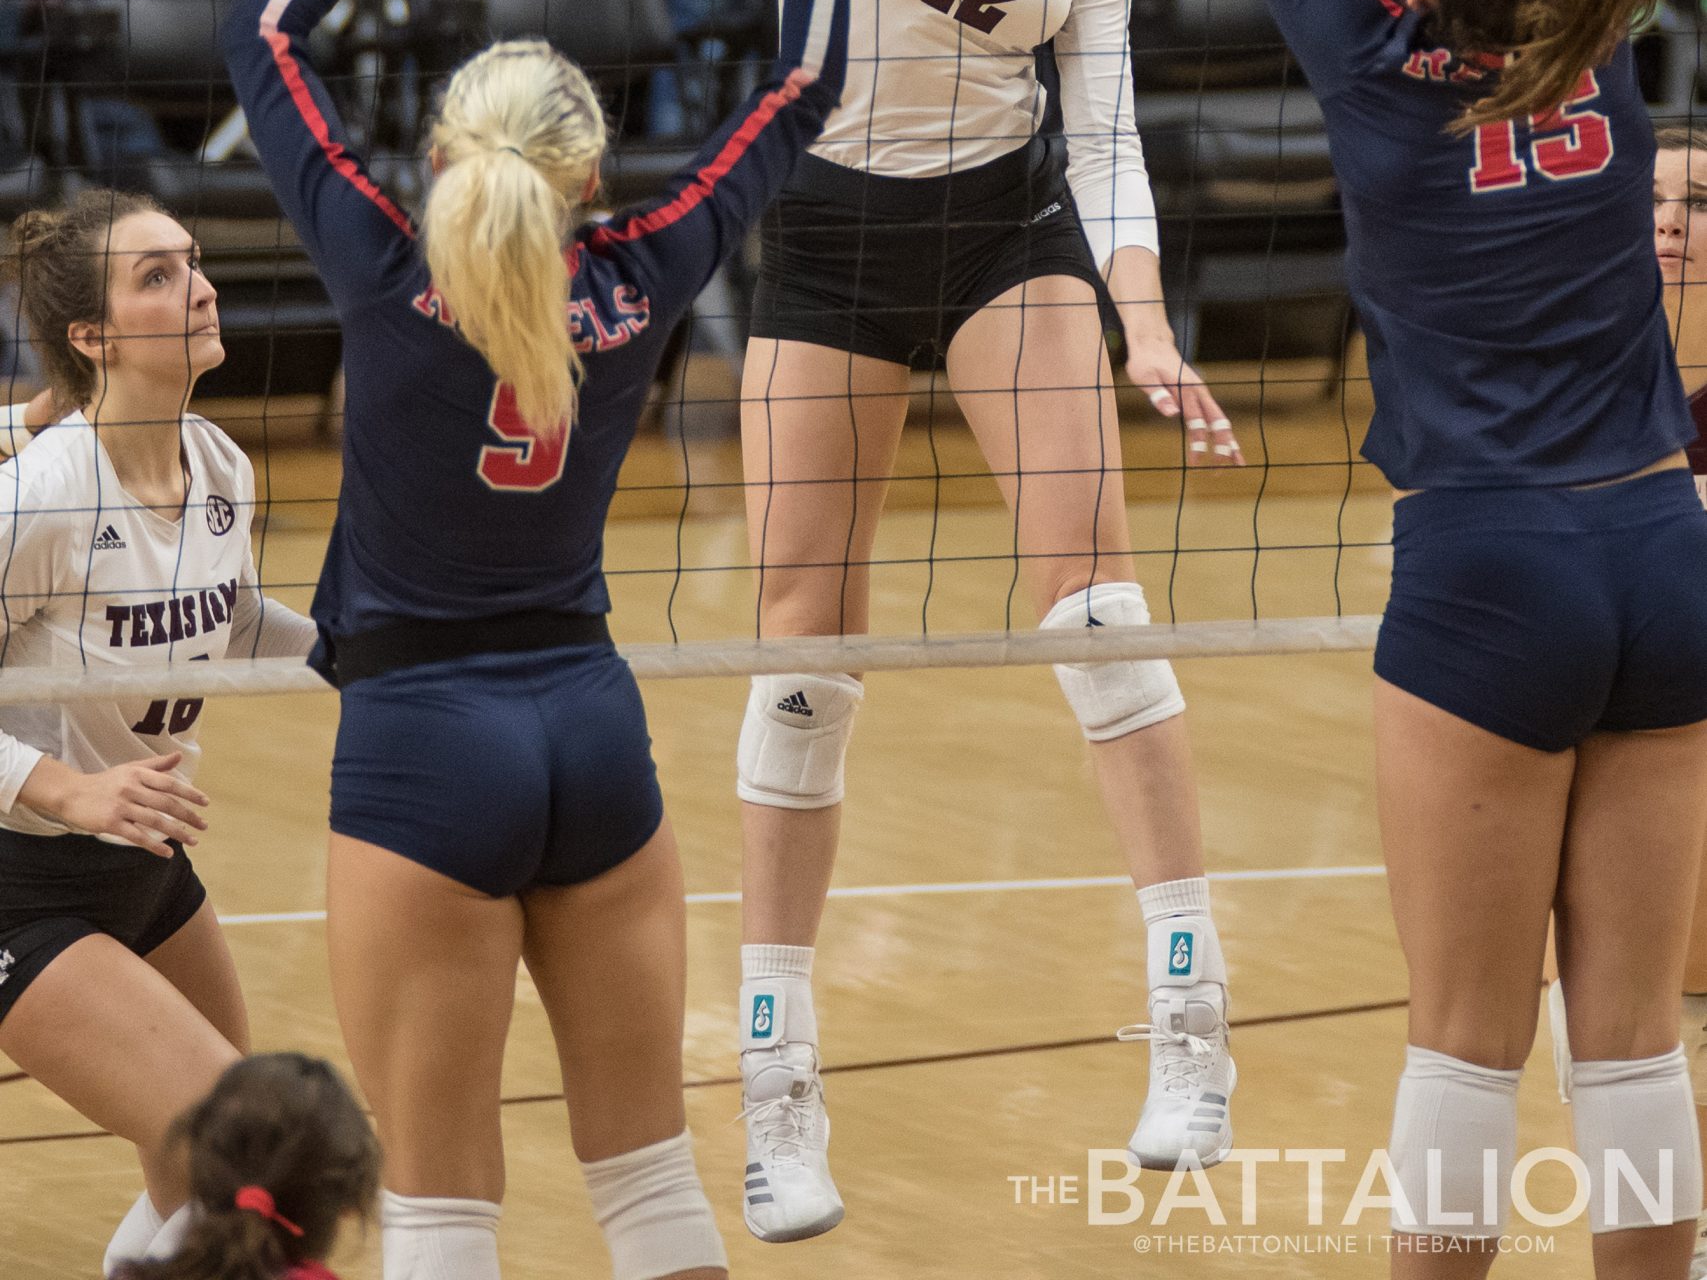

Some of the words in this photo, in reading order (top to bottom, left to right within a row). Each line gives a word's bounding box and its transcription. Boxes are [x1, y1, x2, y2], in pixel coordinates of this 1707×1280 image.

[1469, 68, 1615, 195] 15
[206, 494, 236, 536] SEC
[94, 540, 127, 551] adidas
[106, 594, 197, 647] TEXAS
[776, 701, 814, 717] adidas
